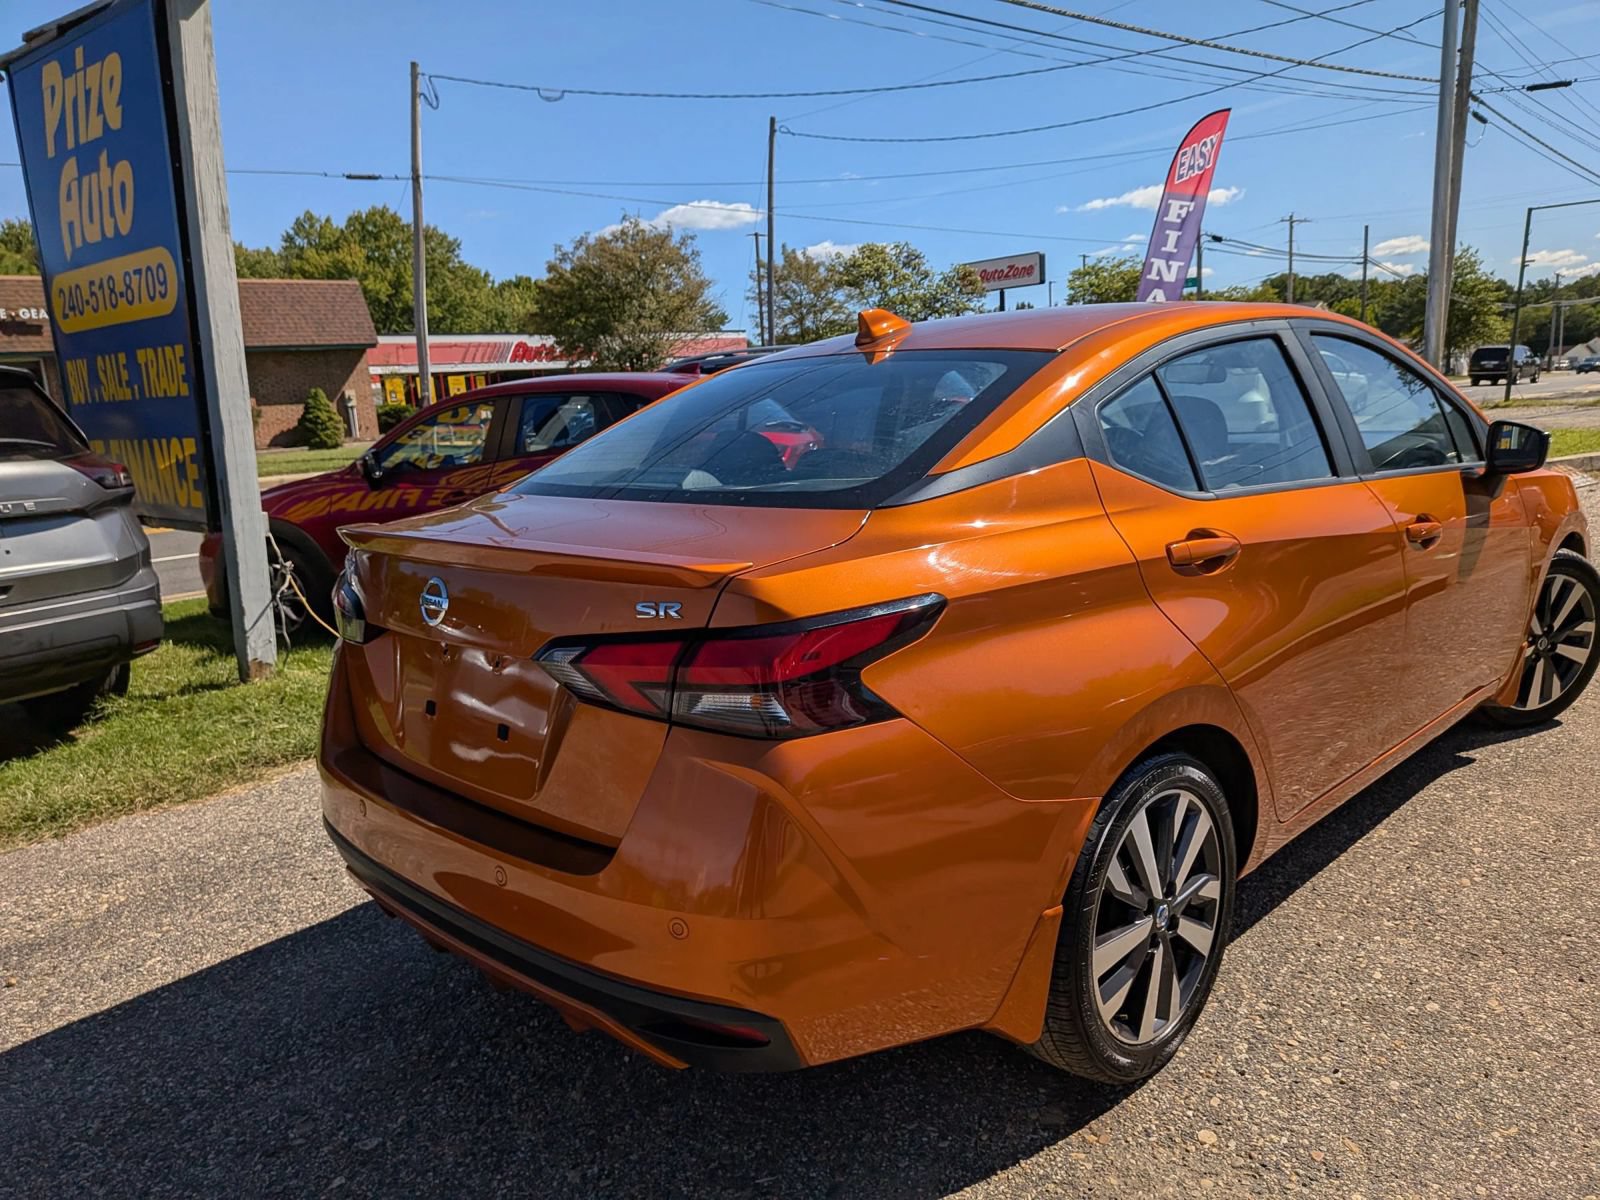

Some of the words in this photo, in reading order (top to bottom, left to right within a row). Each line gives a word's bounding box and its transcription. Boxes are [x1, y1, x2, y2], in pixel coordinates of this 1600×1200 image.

[42, 46, 122, 158] Prize
[1175, 131, 1221, 184] EASY
[60, 148, 134, 260] Auto
[58, 262, 169, 321] 240-518-8709
[978, 264, 1035, 283] AutoZone
[136, 344, 189, 398] TRADE
[635, 601, 683, 619] SR
